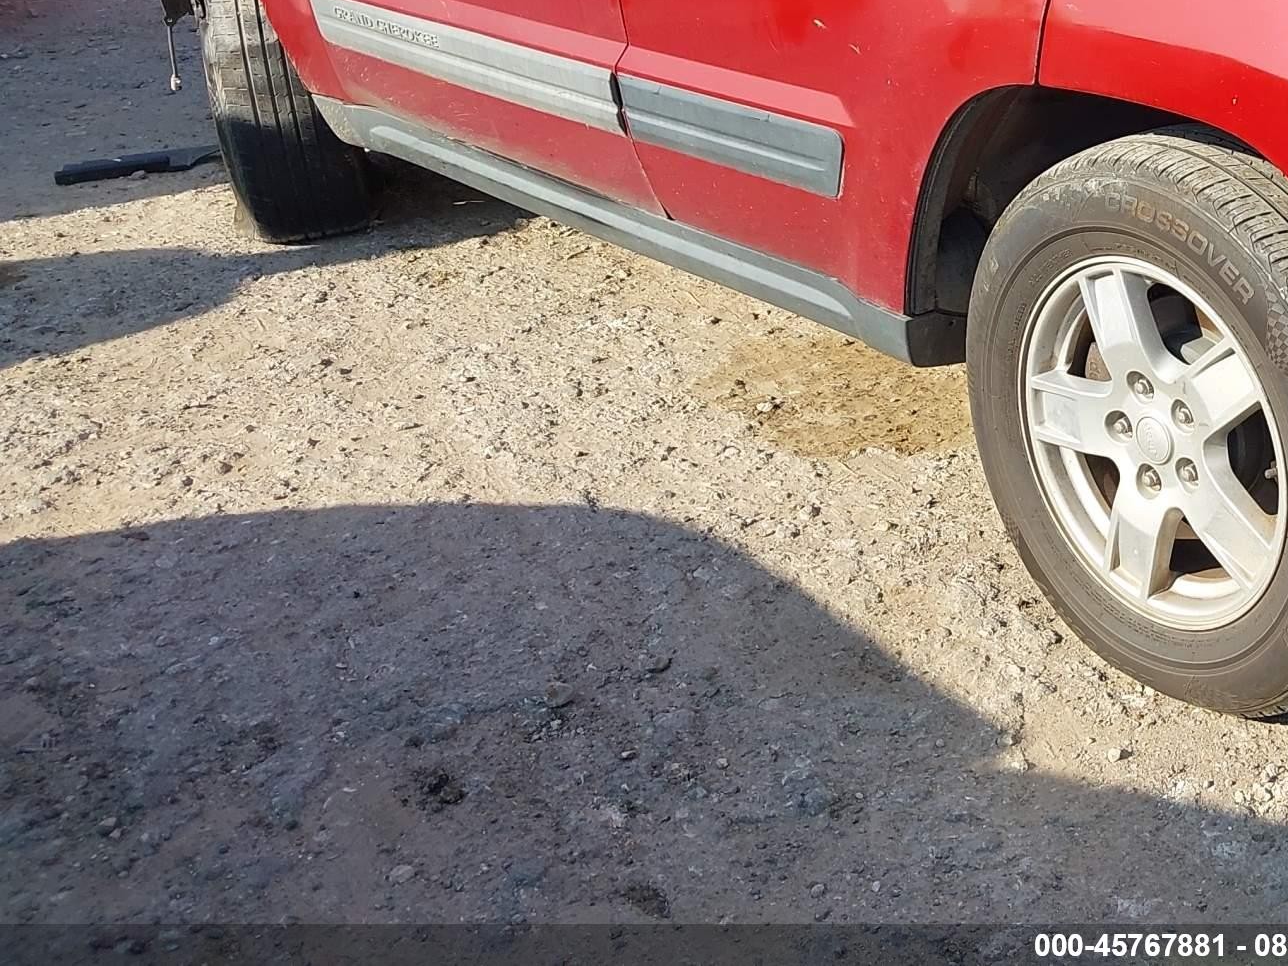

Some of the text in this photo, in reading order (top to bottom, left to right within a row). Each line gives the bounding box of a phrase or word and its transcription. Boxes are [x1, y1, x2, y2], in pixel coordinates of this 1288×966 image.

[333, 5, 440, 49] GRAND CHEROKEE
[1104, 192, 1255, 305] CROSSOVER
